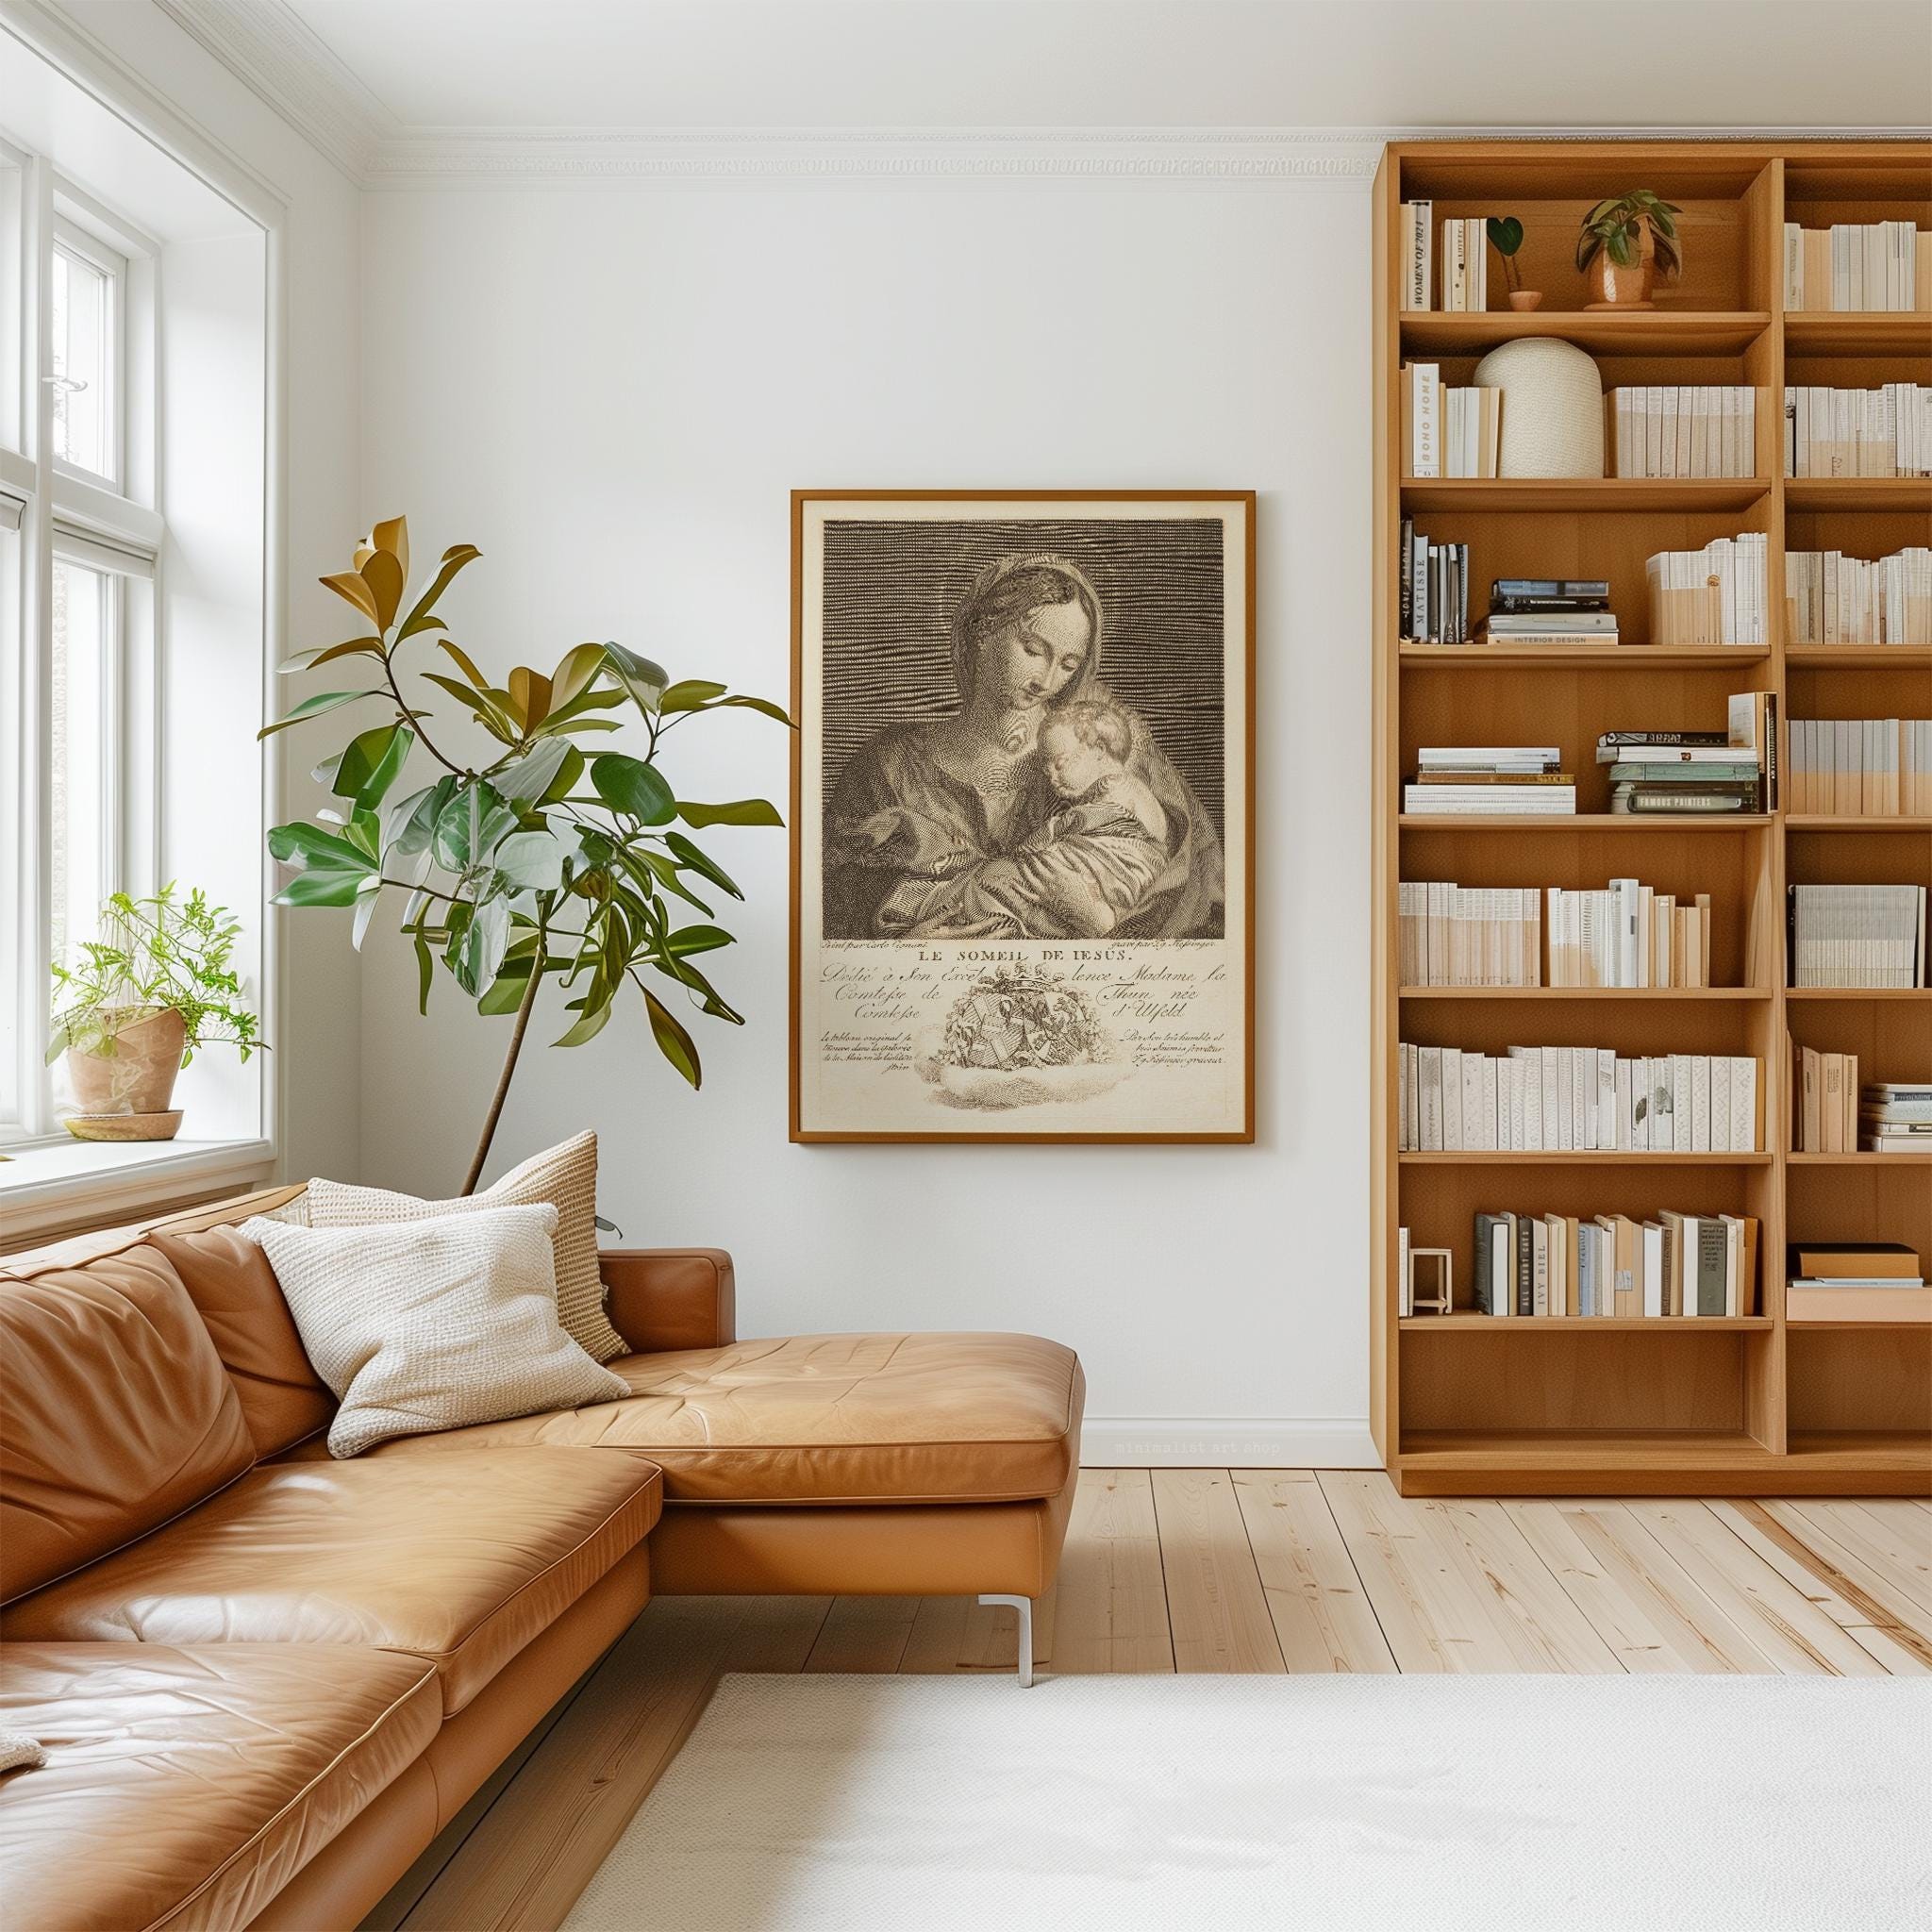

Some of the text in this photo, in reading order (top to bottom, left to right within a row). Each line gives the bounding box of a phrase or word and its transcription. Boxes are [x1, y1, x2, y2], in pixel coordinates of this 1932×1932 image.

[1414, 221, 1424, 306] WOMEN OF 2024
[1422, 375, 1430, 415] HOME
[1422, 422, 1430, 461] BOHO
[1416, 559, 1424, 625] MATISSE
[1640, 798, 1711, 807] FAMOUS PAINTERS
[918, 951, 942, 961] LE
[1041, 950, 1064, 960] DE
[921, 984, 943, 1000] de
[1538, 1245, 1546, 1275] BIEL
